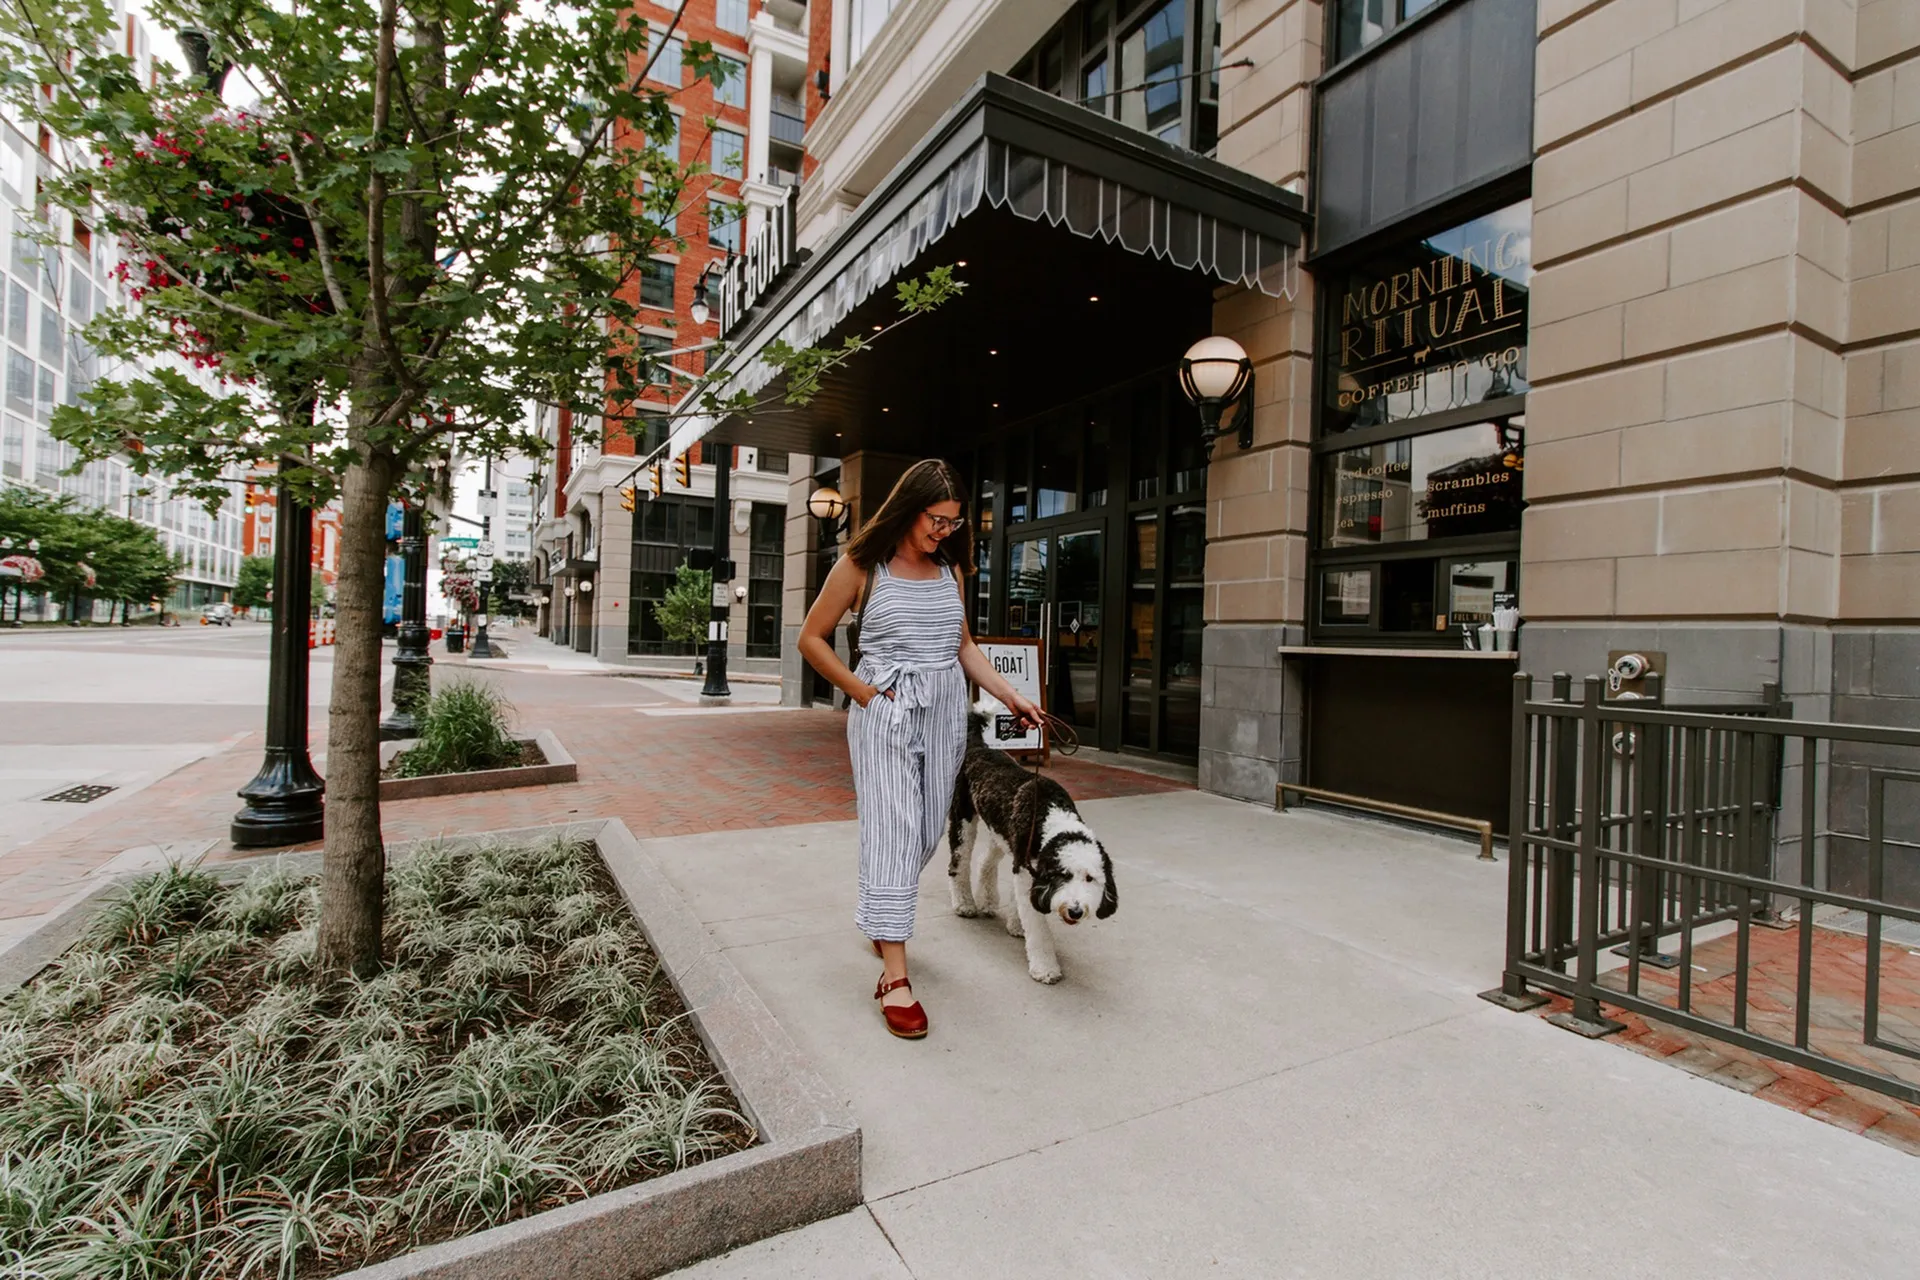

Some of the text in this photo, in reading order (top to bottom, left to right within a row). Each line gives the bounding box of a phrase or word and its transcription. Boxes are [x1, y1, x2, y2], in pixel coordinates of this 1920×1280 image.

[719, 185, 799, 340] THE GOAT
[1343, 231, 1519, 325] MORNING
[1340, 278, 1523, 367] RITUAL
[1338, 372, 1424, 407] COFFEE
[1482, 346, 1520, 369] GO
[1367, 461, 1409, 478] coffee
[1427, 471, 1510, 492] scrambles
[1336, 489, 1393, 505] espresso
[1427, 502, 1486, 519] muffins
[994, 656, 1023, 674] GOAT
